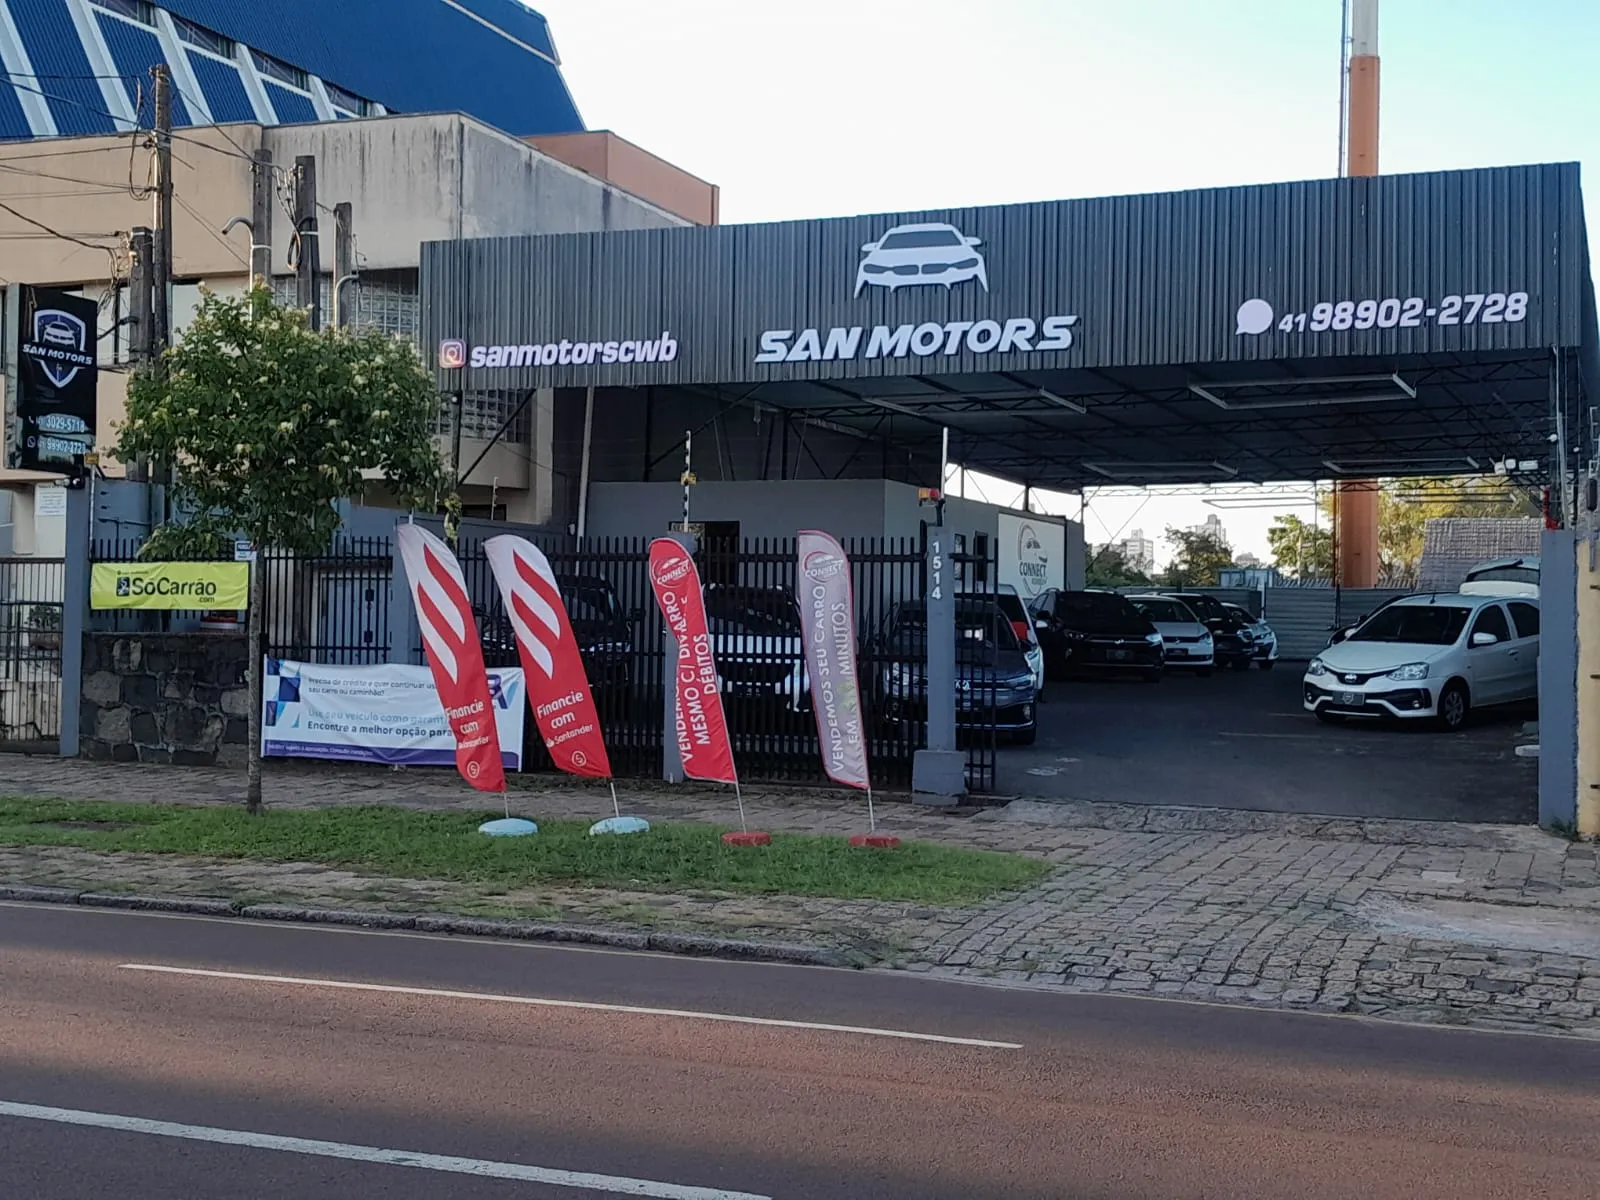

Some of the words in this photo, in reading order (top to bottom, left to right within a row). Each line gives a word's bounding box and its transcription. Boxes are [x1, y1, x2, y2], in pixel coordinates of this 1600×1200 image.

[1278, 312, 1307, 333] 41
[1310, 292, 1528, 331] 98902-2728
[470, 331, 677, 368] sanmotorscwb
[754, 326, 863, 363] SAN
[865, 315, 1078, 358] MOTORS
[23, 344, 46, 356] SAN
[47, 349, 93, 365] MOTORS
[931, 541, 942, 600] 1514
[1019, 561, 1047, 577] CONNECT
[662, 591, 687, 632] ARRO
[813, 586, 826, 644] CARRO
[832, 602, 854, 675] MINUTOS
[680, 664, 696, 683] C/
[816, 649, 829, 676] SEU
[391, 680, 424, 689] continuar
[380, 713, 408, 722] como
[445, 699, 484, 719] Financie
[537, 691, 584, 719] Financie
[684, 687, 711, 744] MESMO
[307, 720, 349, 732] Encontre
[359, 725, 393, 735] melhor
[395, 727, 426, 737] opção
[460, 721, 479, 734] com
[551, 711, 576, 729] com
[821, 679, 844, 772] VENDEMOS
[846, 720, 859, 744] EM
[554, 723, 593, 745] Santander
